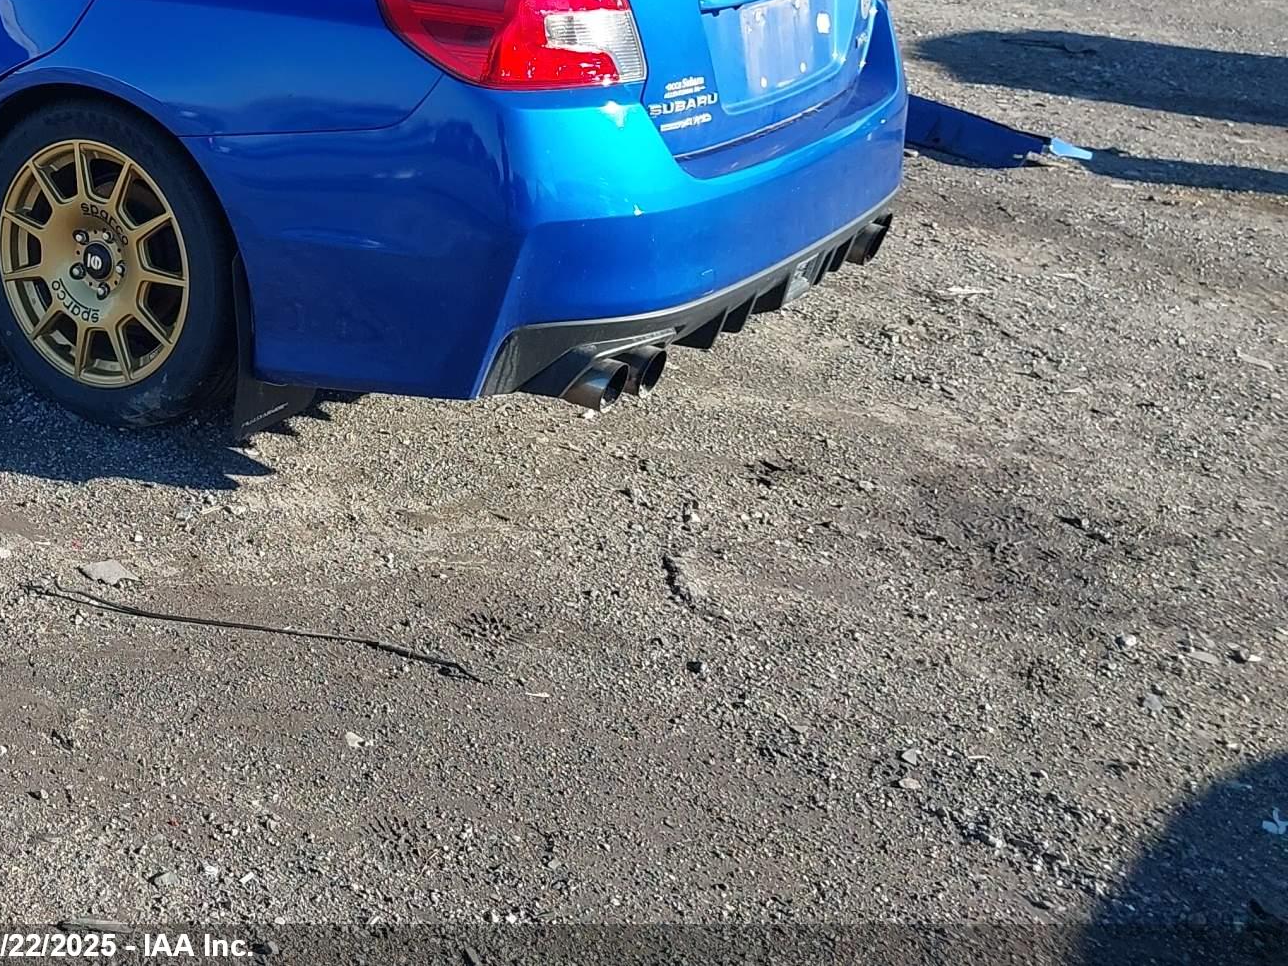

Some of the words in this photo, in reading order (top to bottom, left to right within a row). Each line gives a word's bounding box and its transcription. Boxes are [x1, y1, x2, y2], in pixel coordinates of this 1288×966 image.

[648, 92, 718, 117] SUBARU
[80, 202, 129, 246] sparco
[52, 279, 100, 323] sparco
